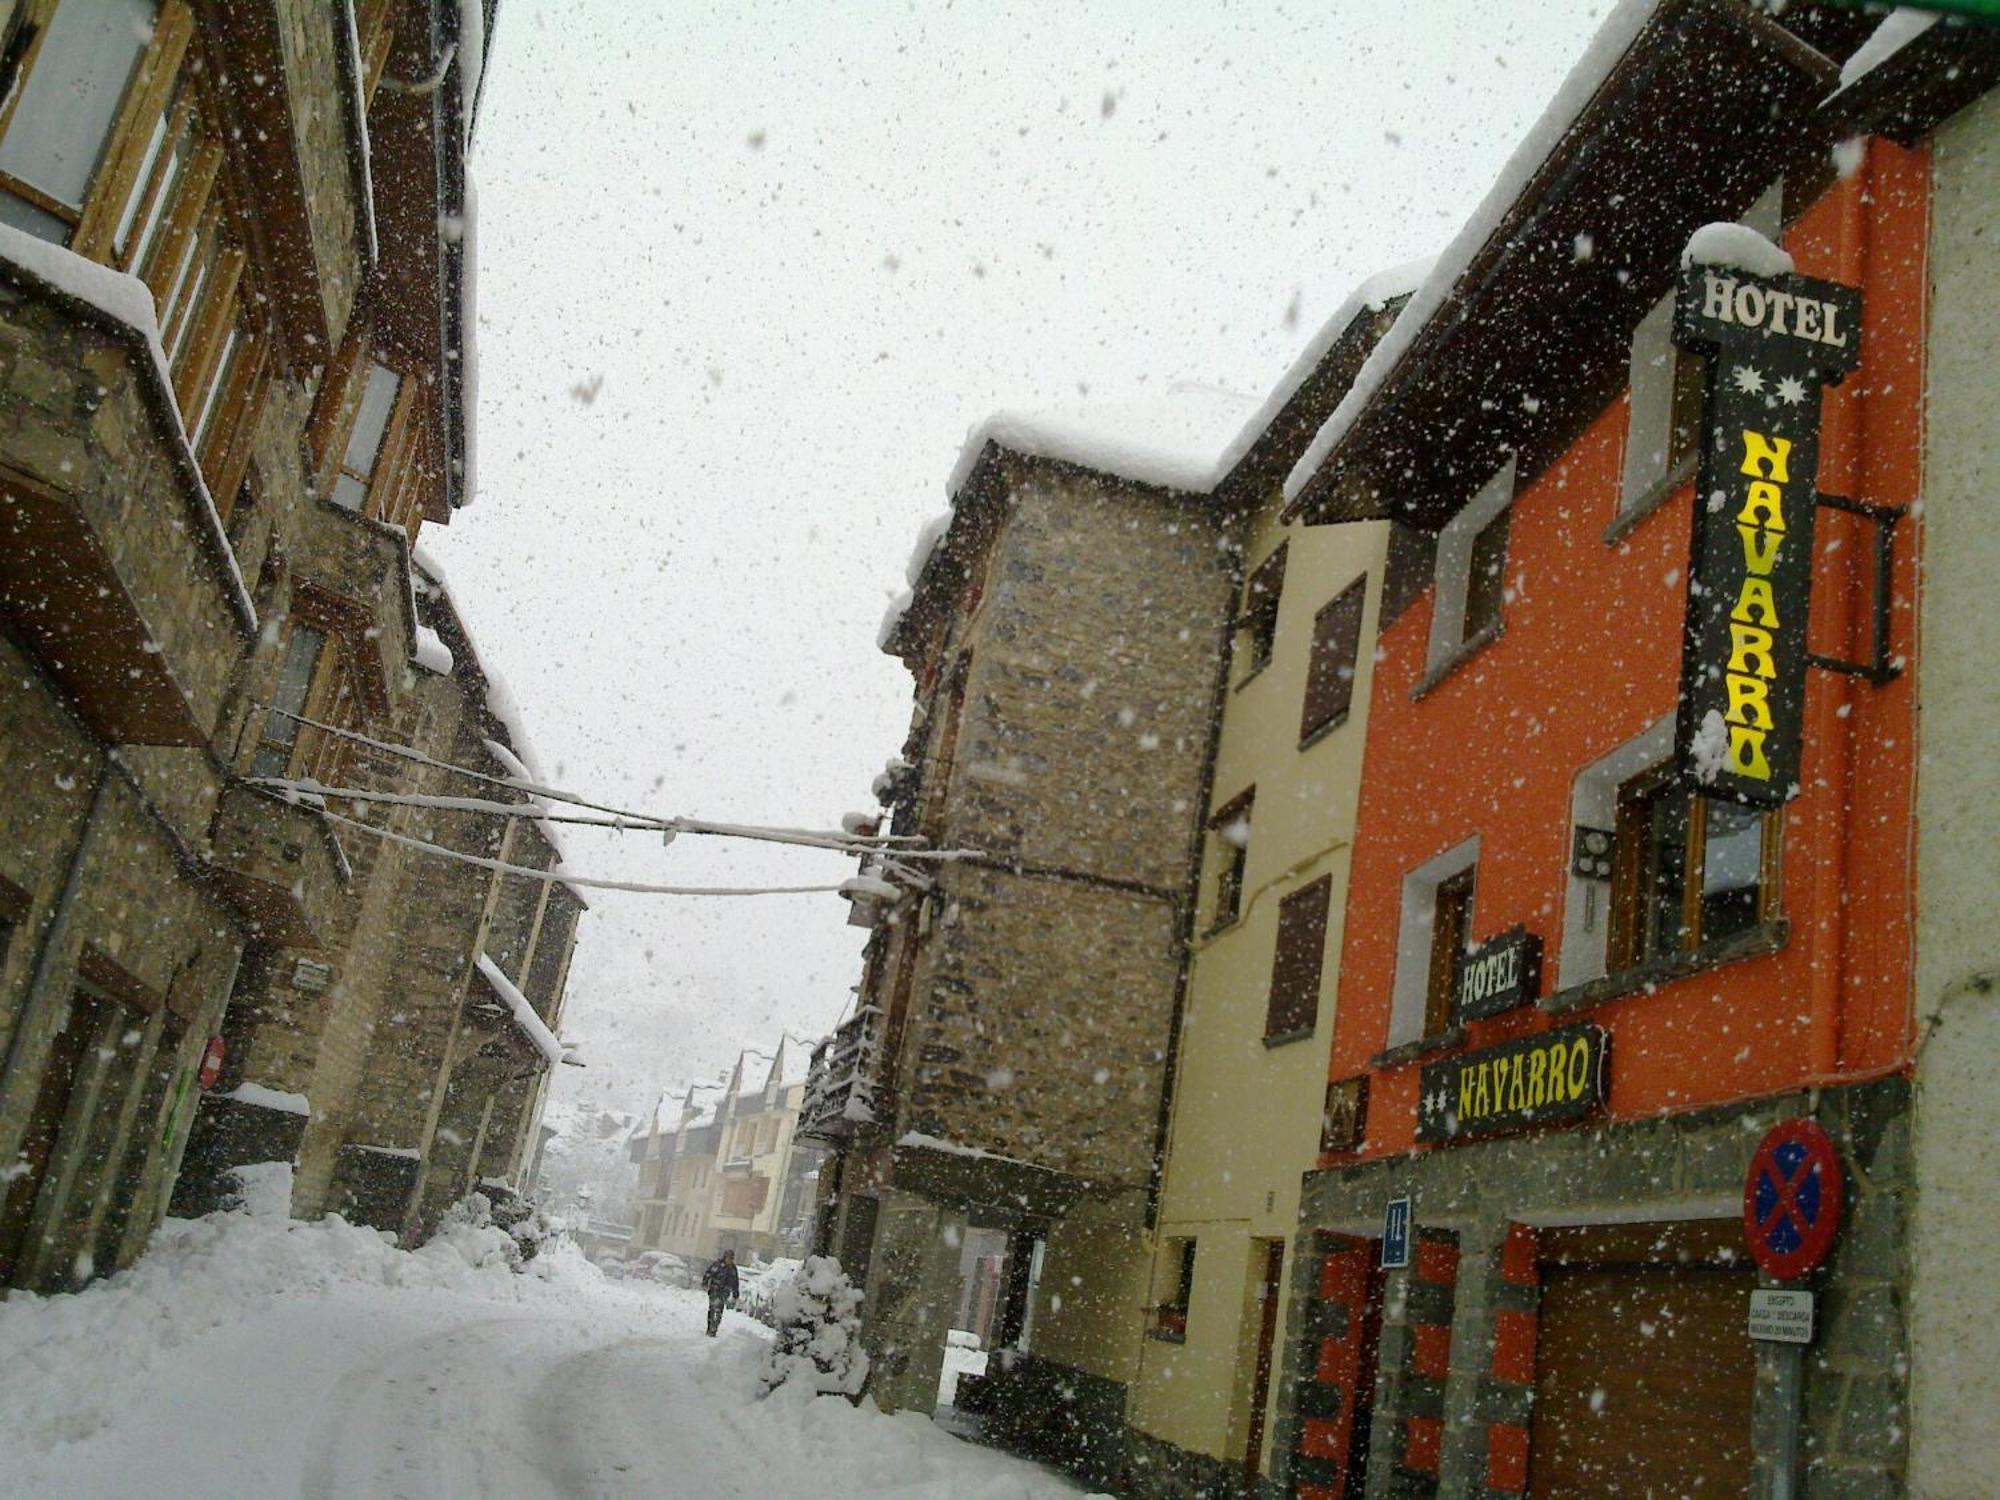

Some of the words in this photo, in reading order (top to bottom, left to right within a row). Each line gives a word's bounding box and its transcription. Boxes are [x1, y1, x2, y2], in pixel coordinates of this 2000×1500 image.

[1702, 269, 1847, 347] HOTEL
[1724, 429, 1791, 781] NAVARRO
[1461, 948, 1518, 1006] HOTEL
[1457, 1037, 1589, 1121] NAVARRO
